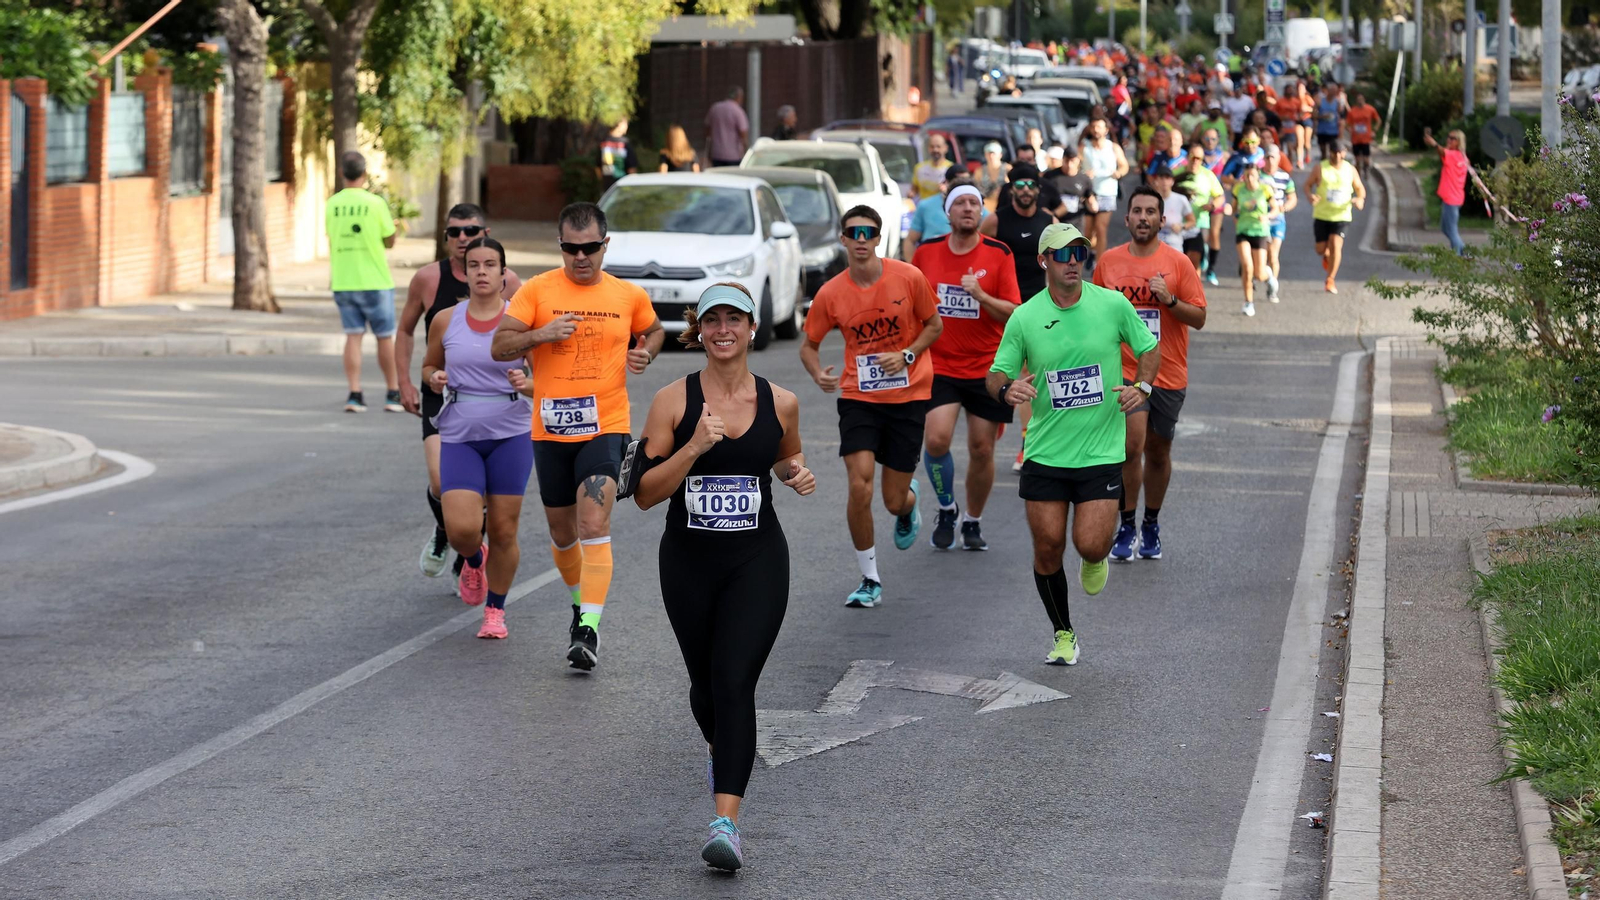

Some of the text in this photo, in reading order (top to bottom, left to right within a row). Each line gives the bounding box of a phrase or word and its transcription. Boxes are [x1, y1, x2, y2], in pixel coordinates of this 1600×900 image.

[335, 205, 368, 216] STAFF
[944, 295, 971, 308] 1041
[1060, 380, 1090, 396] 762
[554, 410, 584, 424] 738
[698, 494, 749, 513] 1030
